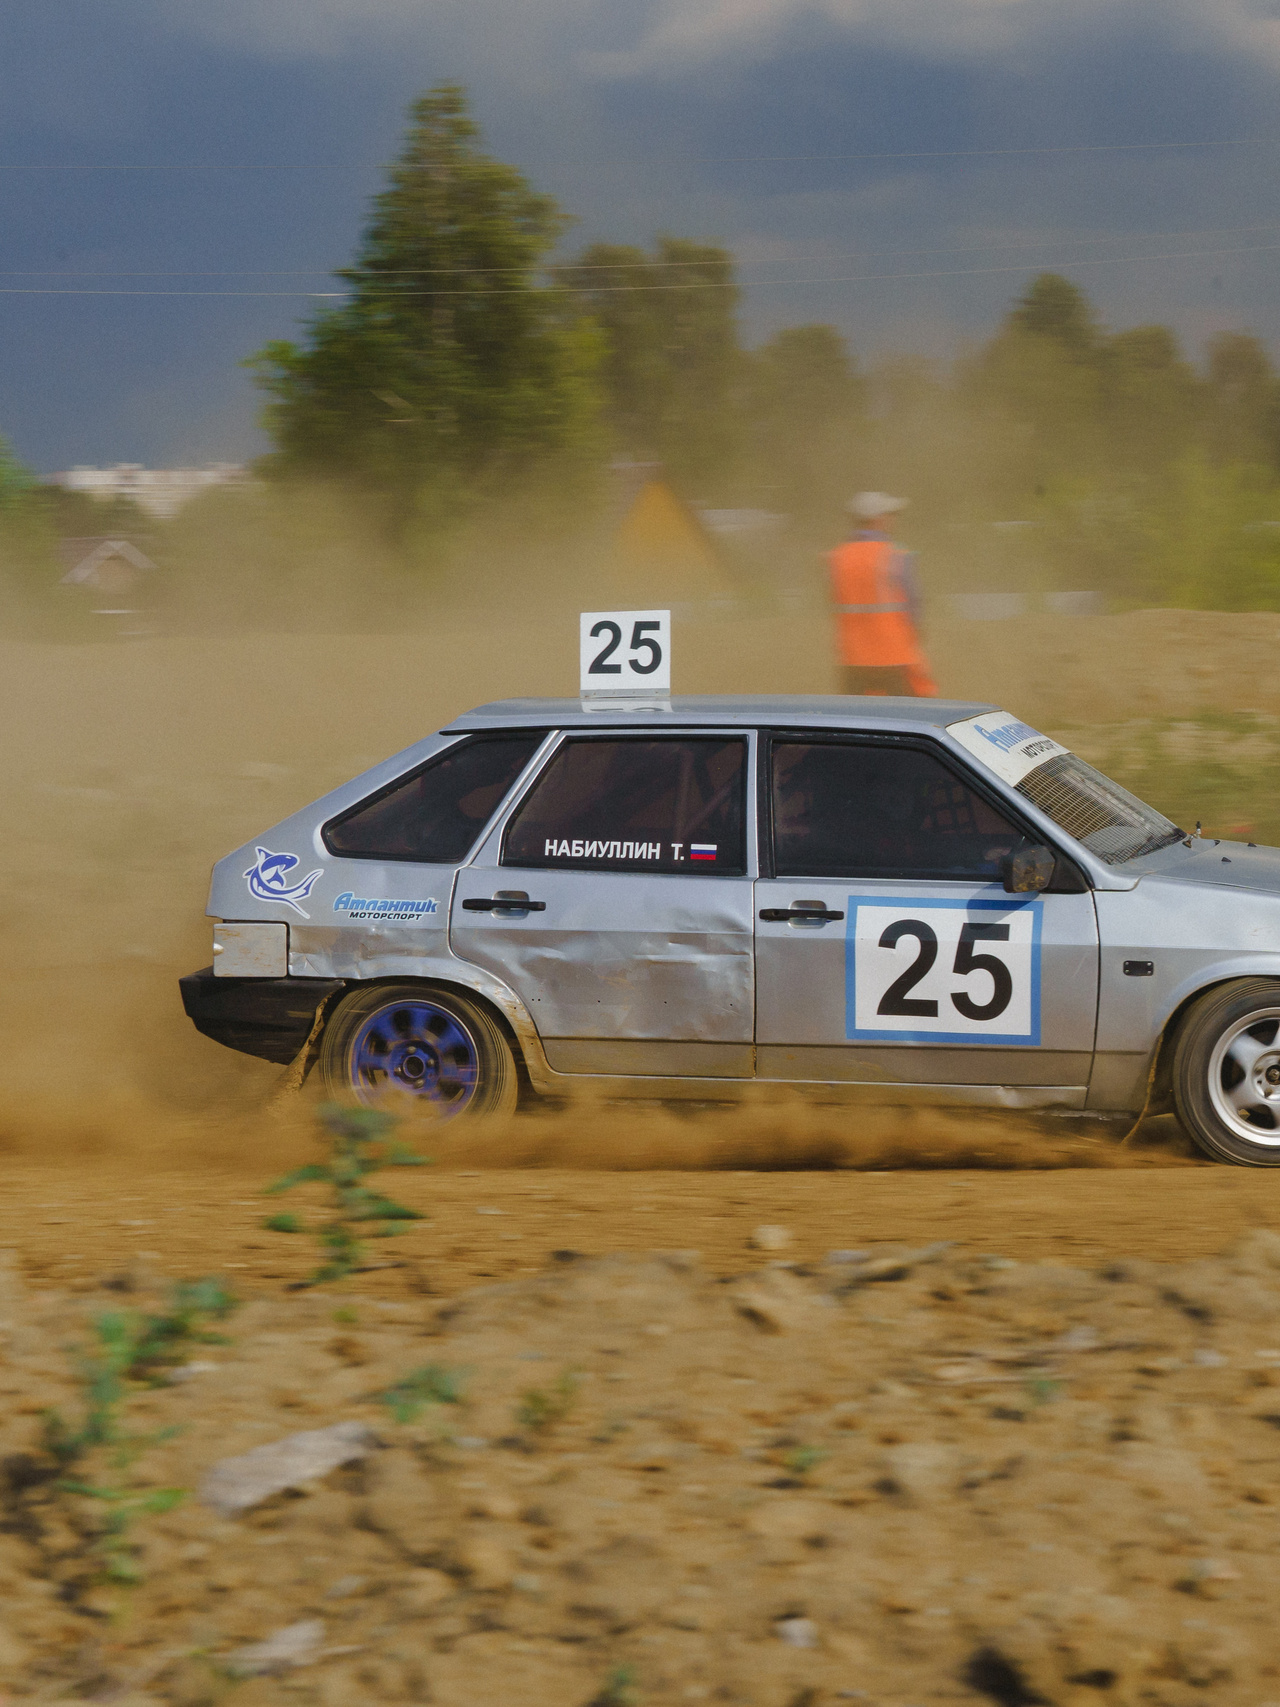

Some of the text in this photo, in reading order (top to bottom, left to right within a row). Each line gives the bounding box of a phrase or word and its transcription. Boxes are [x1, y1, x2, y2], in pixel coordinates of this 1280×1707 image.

[588, 620, 662, 674] 25
[544, 839, 685, 861] НАБИУЛЛИН Т.
[333, 891, 438, 913] Атлантик
[349, 911, 422, 920] МОТОРСПОРТ
[876, 918, 1013, 1021] 25
